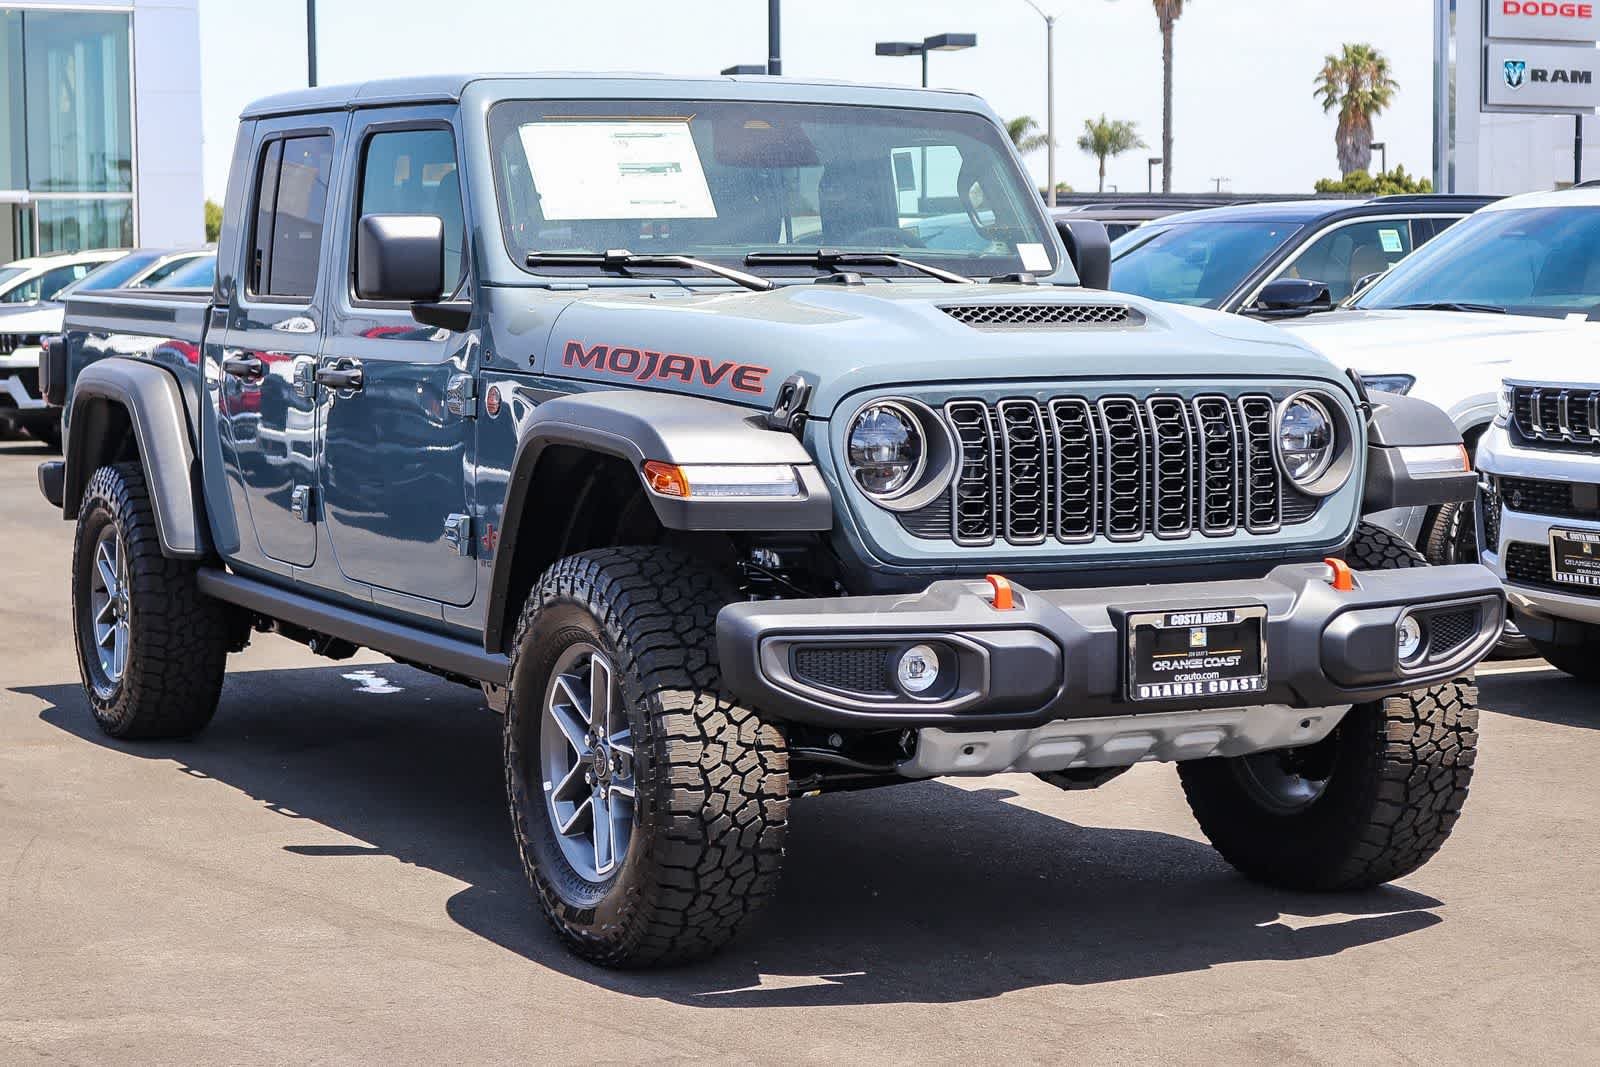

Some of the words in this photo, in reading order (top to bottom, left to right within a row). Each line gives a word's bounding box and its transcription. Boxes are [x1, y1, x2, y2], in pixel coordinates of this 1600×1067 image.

[1503, 1, 1592, 18] DODGE
[1531, 68, 1592, 84] RAM
[562, 339, 771, 395] MOJAVE
[1170, 613, 1202, 626] COSTA
[1202, 611, 1228, 624] MESA
[1152, 658, 1203, 671] ORANGE
[1203, 655, 1241, 668] COAST
[1174, 671, 1219, 682] ocauto.com
[1140, 683, 1203, 698] ORANGE
[1209, 677, 1259, 693] COAST
